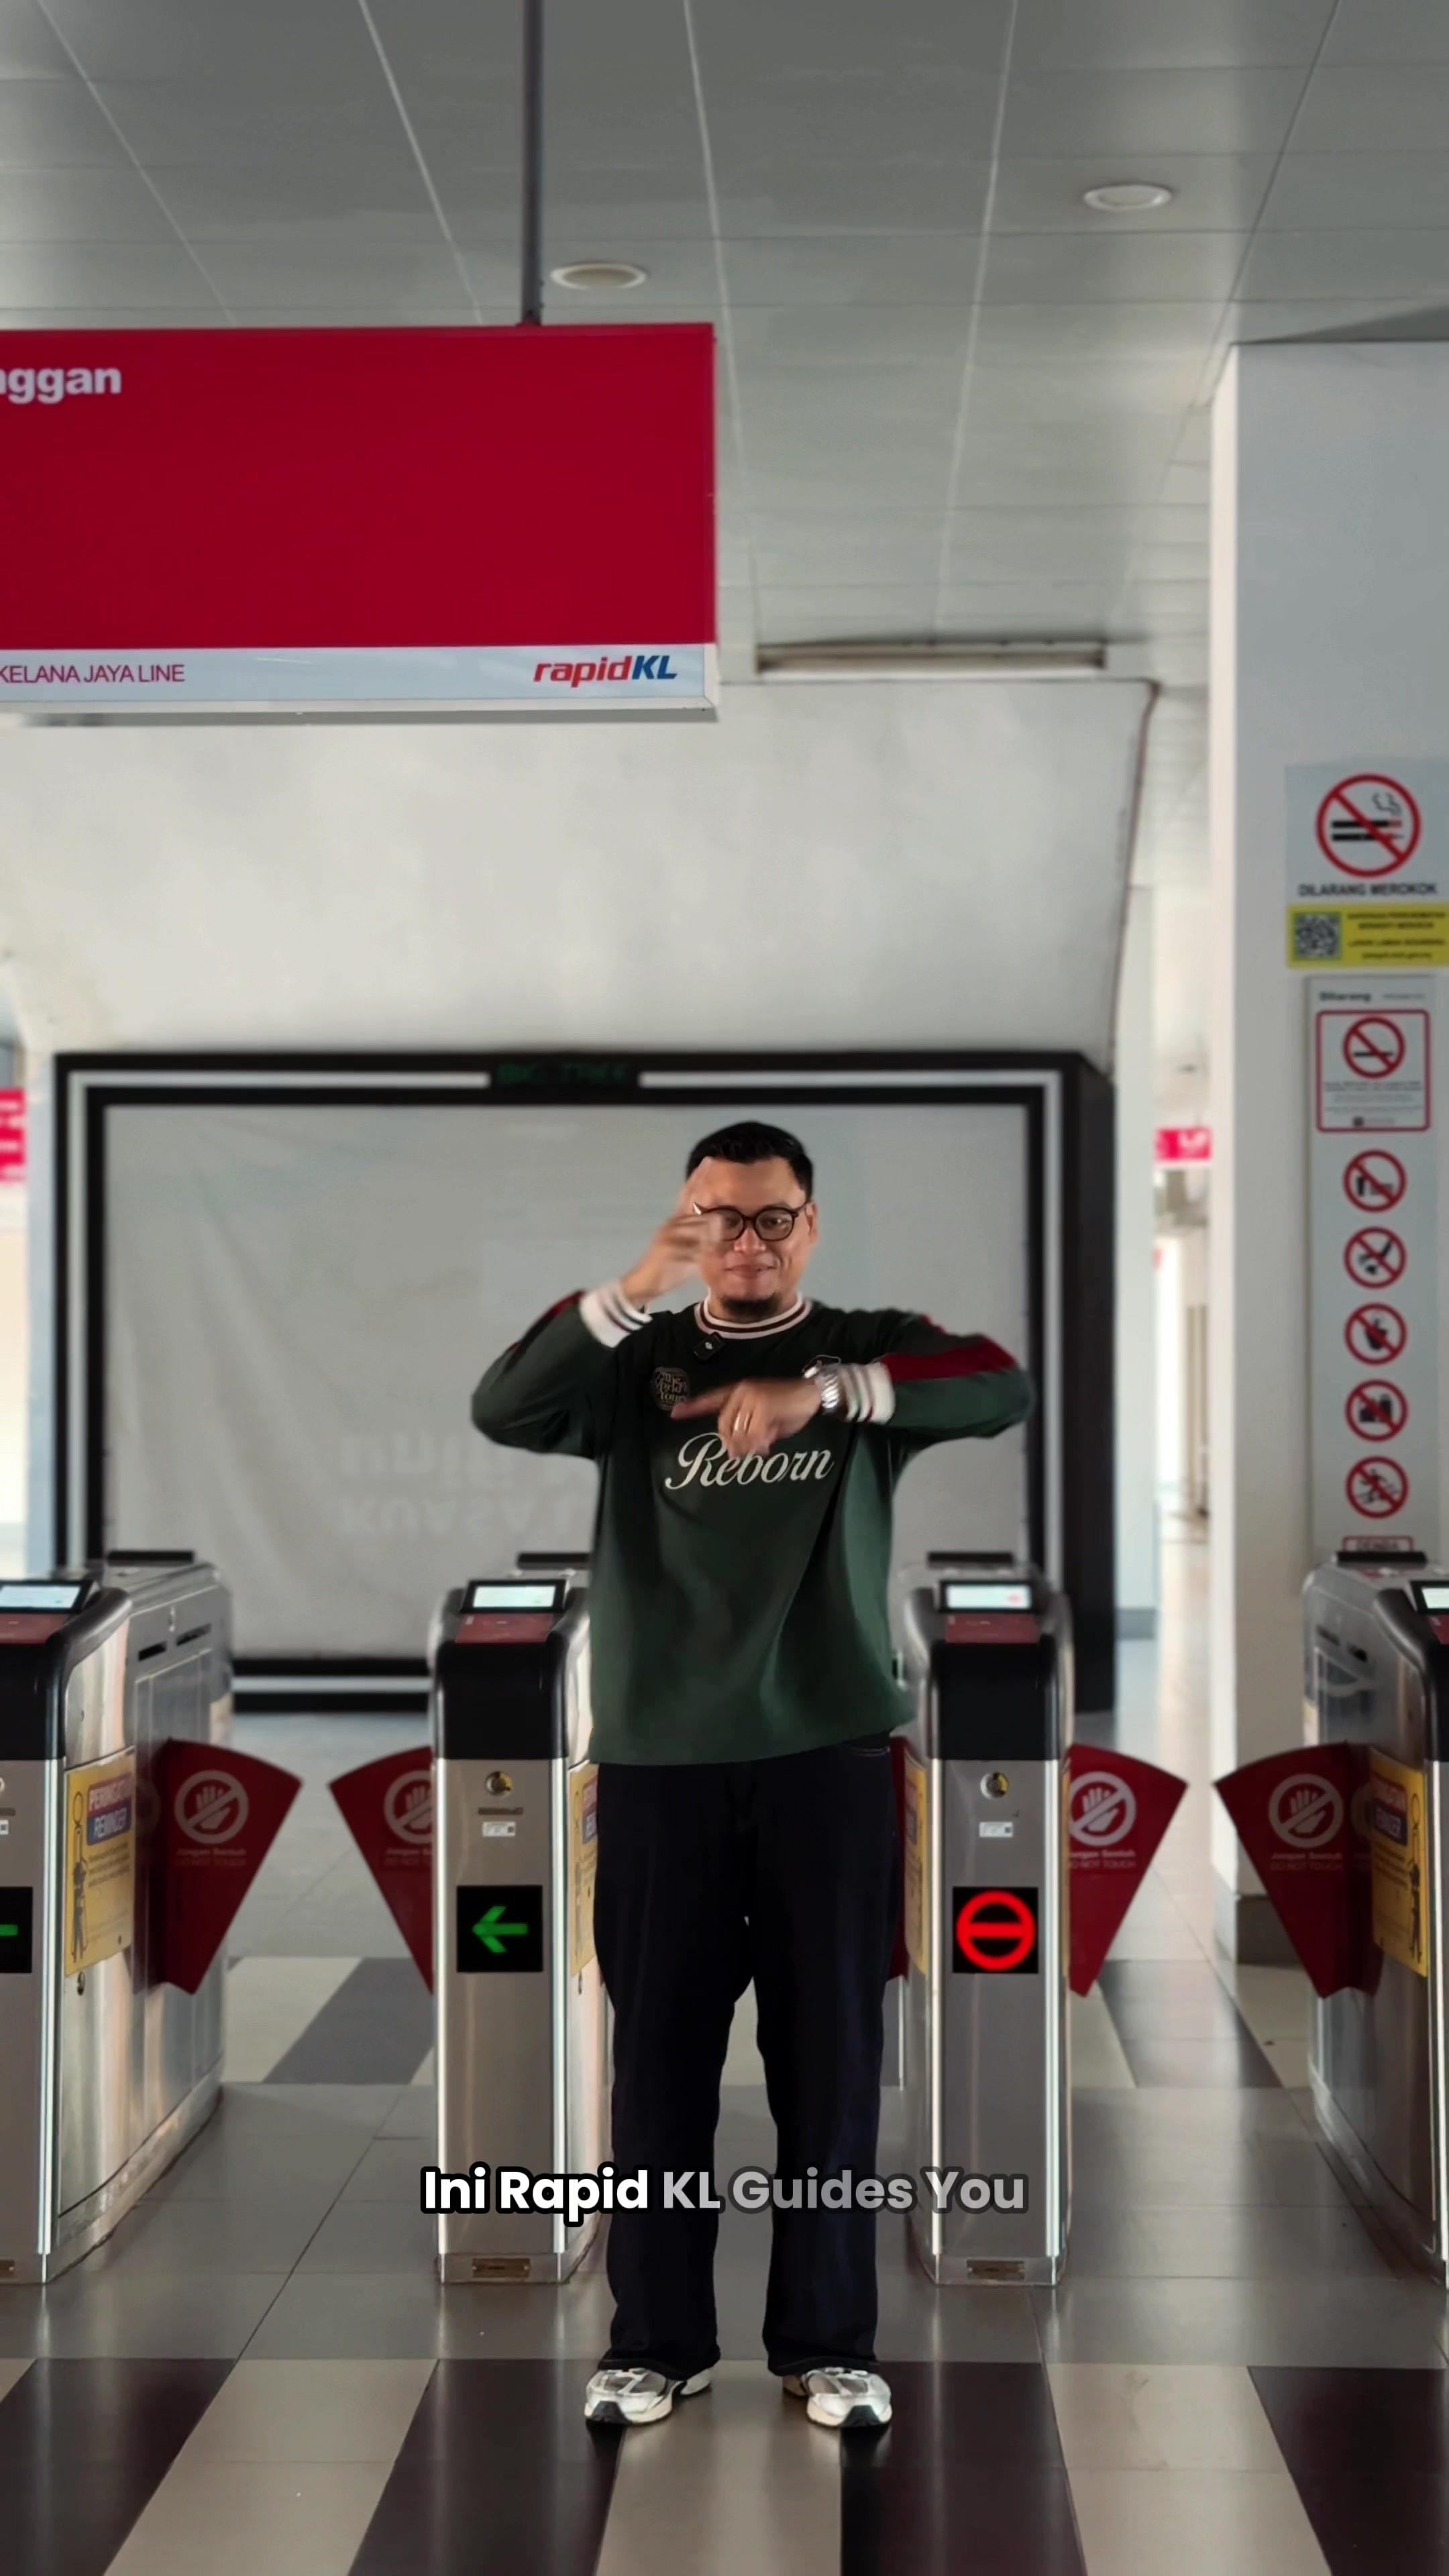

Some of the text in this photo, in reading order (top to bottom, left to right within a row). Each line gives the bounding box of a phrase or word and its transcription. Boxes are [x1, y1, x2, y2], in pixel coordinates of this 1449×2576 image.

[0, 367, 122, 404] ggan
[0, 663, 186, 683] KELANA JAYA LINE
[533, 655, 678, 688] rapidKL
[1297, 882, 1438, 897] DILARANG MEROKOK
[665, 1432, 835, 1490] Reborn
